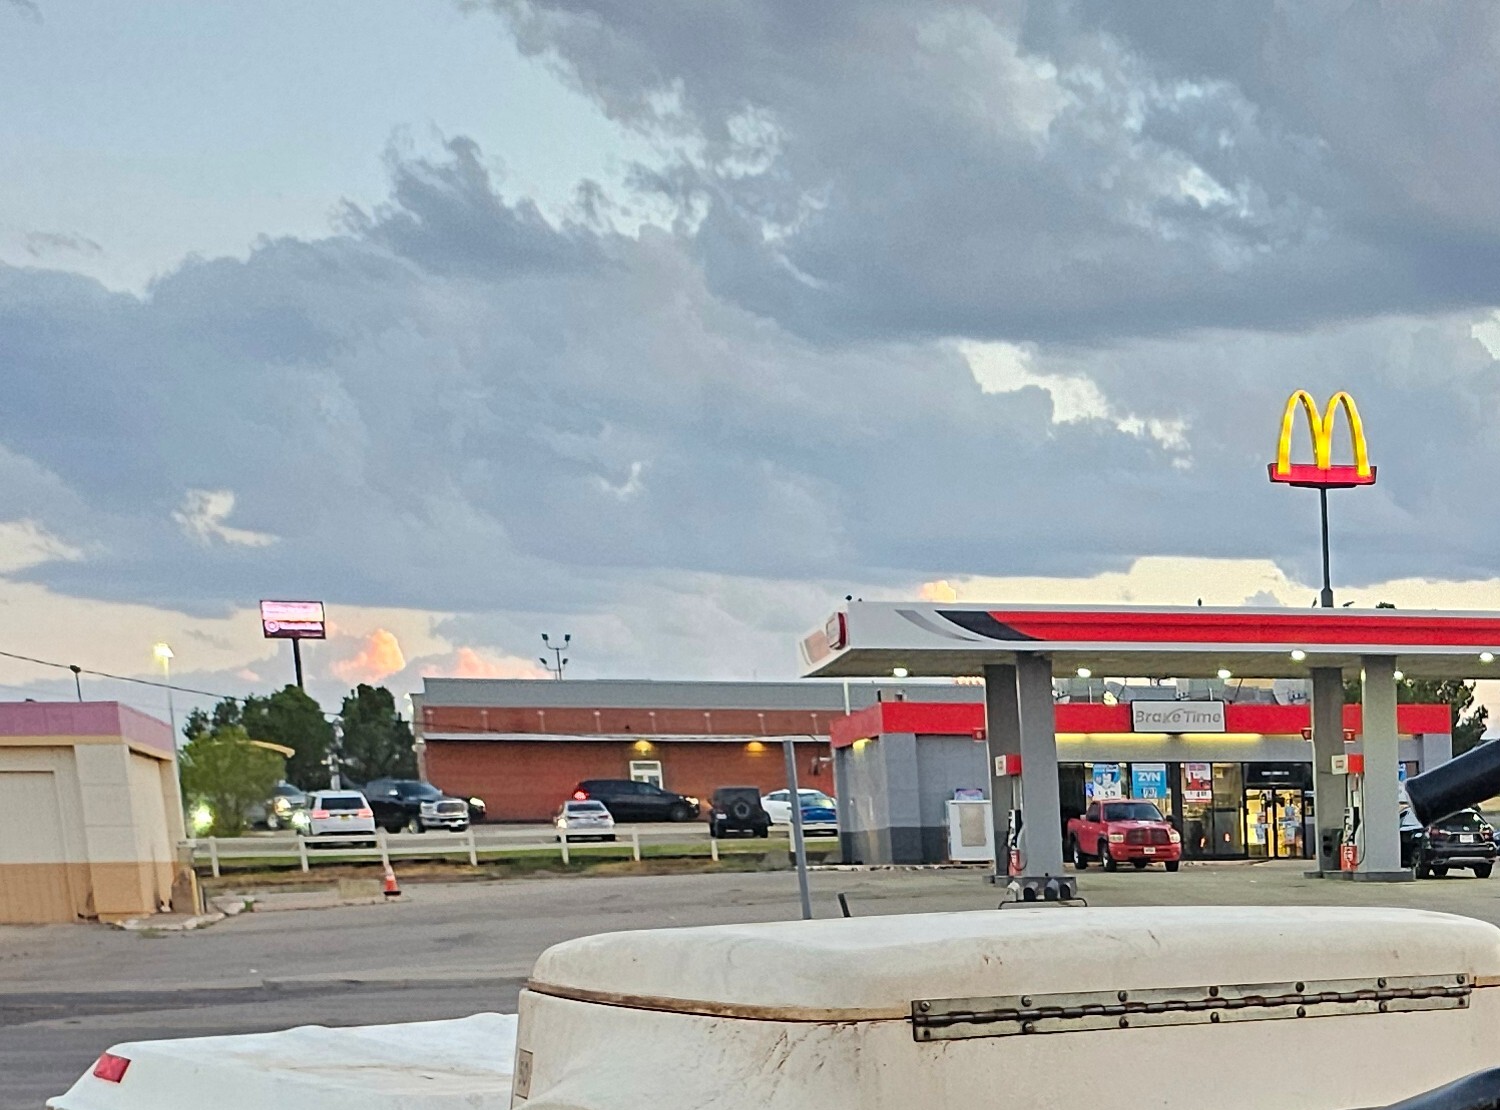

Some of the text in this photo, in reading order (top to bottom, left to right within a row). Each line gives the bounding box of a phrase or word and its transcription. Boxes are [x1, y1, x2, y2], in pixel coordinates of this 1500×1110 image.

[1135, 708, 1222, 724] Brake Time
[1138, 772, 1161, 782] ZYN
